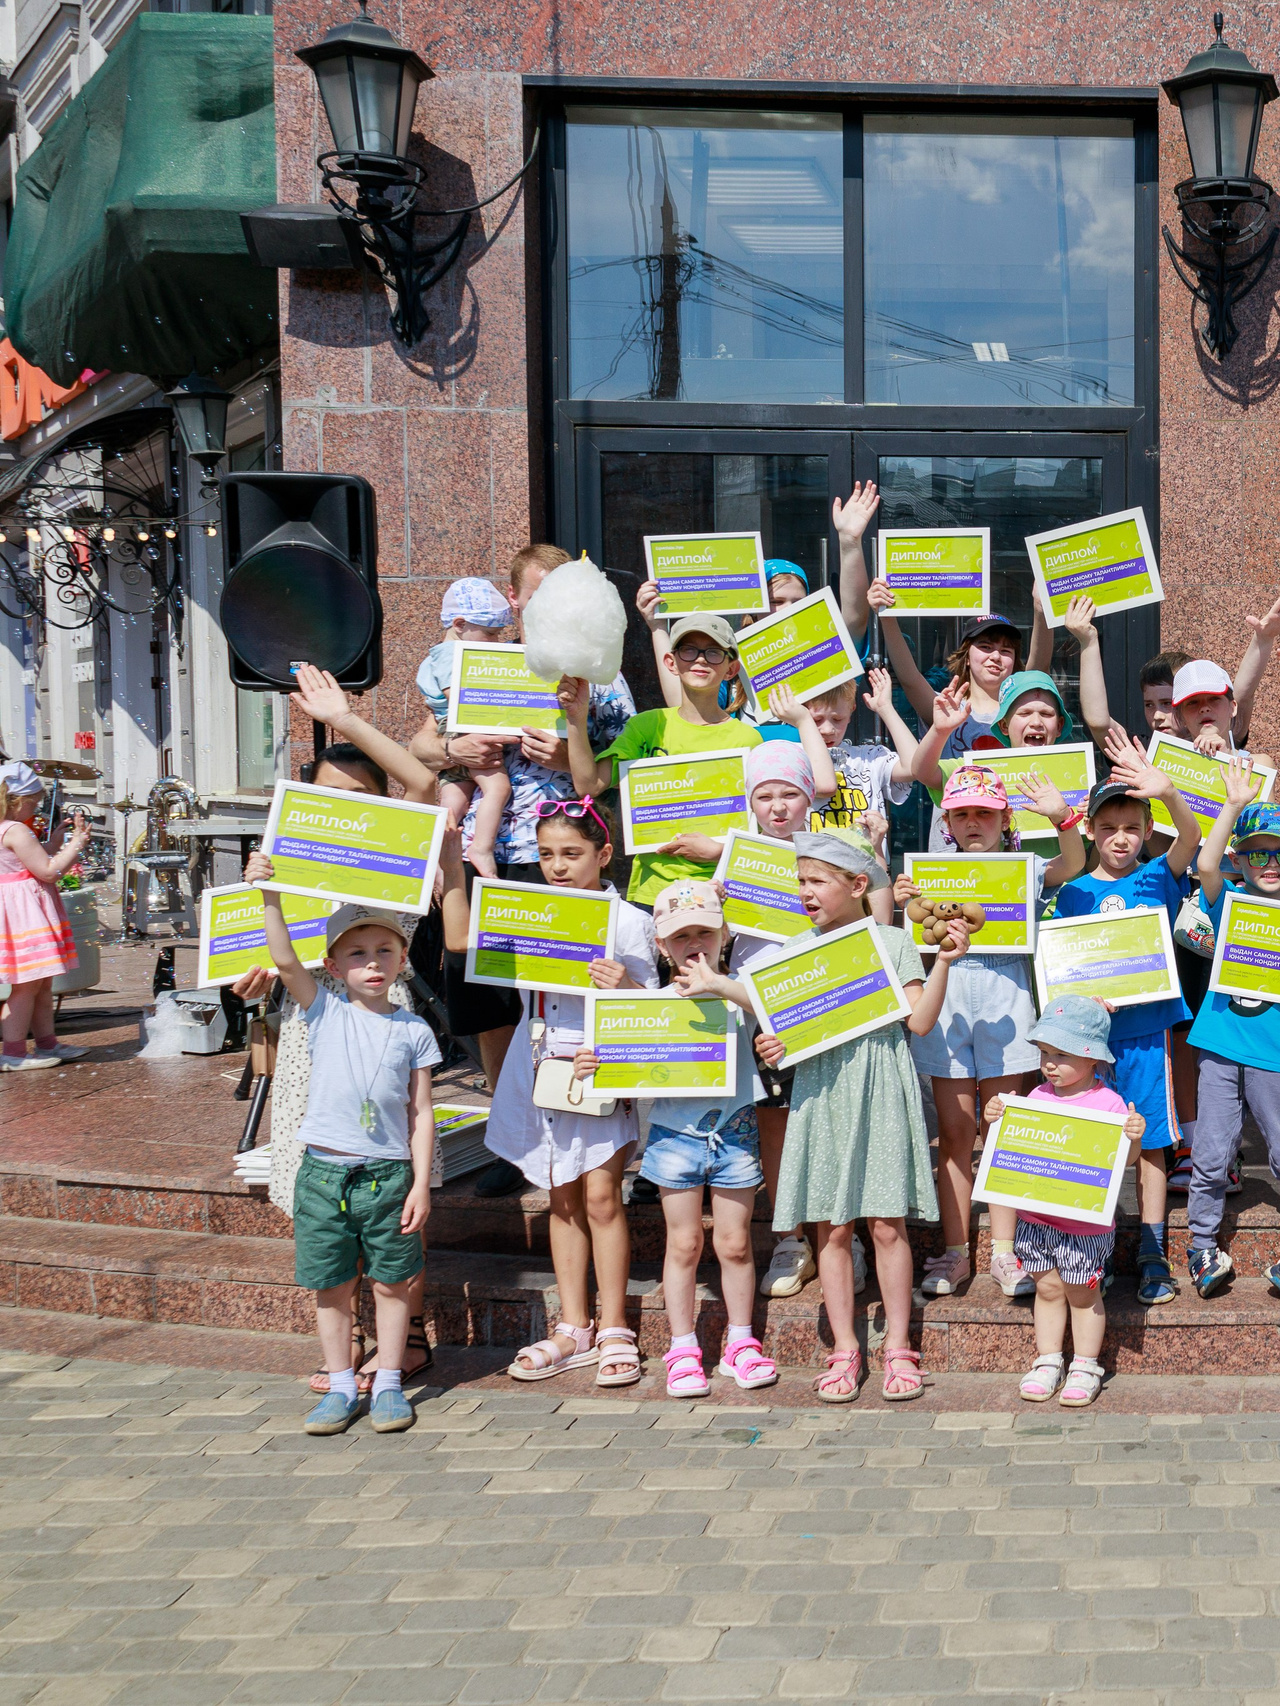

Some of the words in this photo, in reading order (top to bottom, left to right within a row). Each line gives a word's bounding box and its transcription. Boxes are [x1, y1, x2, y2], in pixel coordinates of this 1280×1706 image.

[656, 554, 712, 566] ДИПЛОМ
[890, 551, 941, 562] ДИПЛОМ
[1043, 545, 1098, 568] ДИПЛОМ
[748, 632, 797, 663] ДИПЛОМ
[465, 665, 529, 679] ДИПЛОМ
[1156, 759, 1215, 787] ДИПЛОМ
[633, 777, 694, 795] ДИПЛОМ
[828, 787, 869, 811] ЭТО
[286, 809, 368, 834] ДИПЛОМ
[278, 846, 310, 857] ЮНОМУ
[311, 851, 360, 866] КОНДИТЕРУ
[280, 839, 311, 850] ВЫДАН
[310, 844, 346, 855] САМОМУ
[347, 850, 411, 866] ТАЛАНТЛИВОМУ
[733, 854, 799, 882] ДИПЛОМ
[485, 905, 552, 925] ДИПЛОМ
[1227, 953, 1253, 962] ЮНОМУ
[1228, 946, 1253, 956] ВЫДАН
[1252, 950, 1280, 960] САМОМУ
[761, 964, 827, 1001] ДИПЛОМ
[772, 1008, 798, 1023] ВЫДАН
[796, 997, 825, 1013] САМОМУ
[824, 976, 875, 1001] ТАЛАНТЛИВОМУ
[599, 1016, 669, 1029] ДИПЛОМ
[775, 1014, 801, 1030] ЮНОМУ
[801, 998, 840, 1019] КОНДИТЕРУ
[1003, 1123, 1067, 1146] ДИПЛОМ
[995, 1159, 1020, 1169] ЮНОМУ
[1020, 1163, 1059, 1177] КОНДИТЕРУ
[997, 1152, 1021, 1162] ВЫДАН
[1020, 1156, 1049, 1167] САМОМУ
[1048, 1162, 1100, 1177] ТАЛАНТЛИВОМУ
